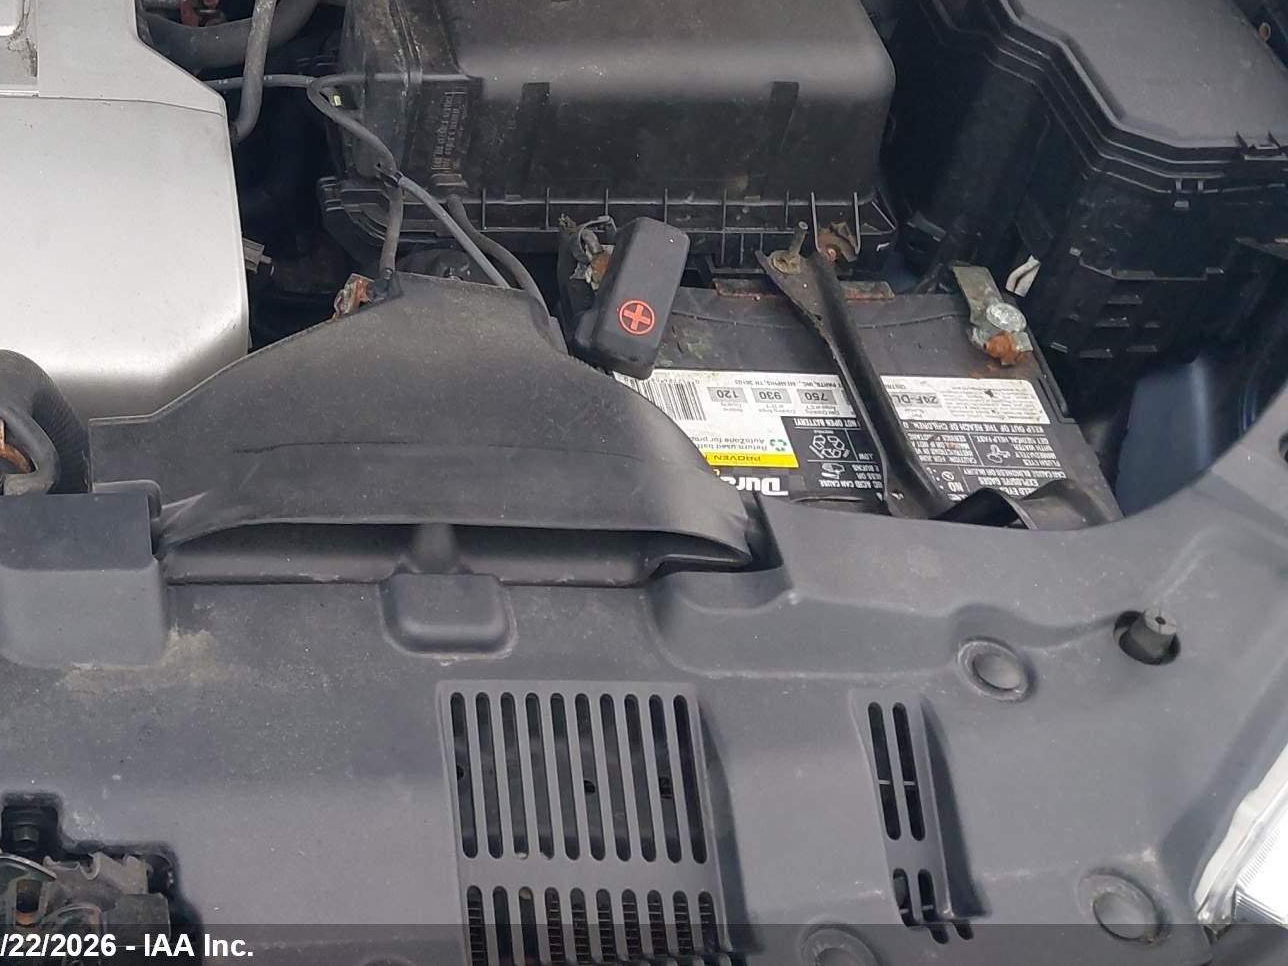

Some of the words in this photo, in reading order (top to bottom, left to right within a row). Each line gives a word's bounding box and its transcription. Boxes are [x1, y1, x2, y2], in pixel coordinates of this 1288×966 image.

[716, 389, 739, 399] 120
[759, 391, 782, 400] 930
[804, 392, 827, 401] 750
[793, 417, 825, 427] BATTERY!
[825, 418, 844, 427] OPEN
[843, 419, 858, 427] NOT
[949, 423, 959, 431] OF
[959, 423, 983, 431] REACH
[999, 424, 1010, 432] OF
[1026, 425, 1044, 433] KEEP
[1035, 444, 1054, 452] WITH
[713, 454, 761, 462] PROVEN
[818, 479, 840, 488] CAUSE
[840, 480, 855, 488] CAN
[854, 480, 872, 489] ACID
[978, 476, 1001, 486] GASES
[1000, 477, 1039, 487] EXPLOSIVE
[947, 481, 965, 492] NO
